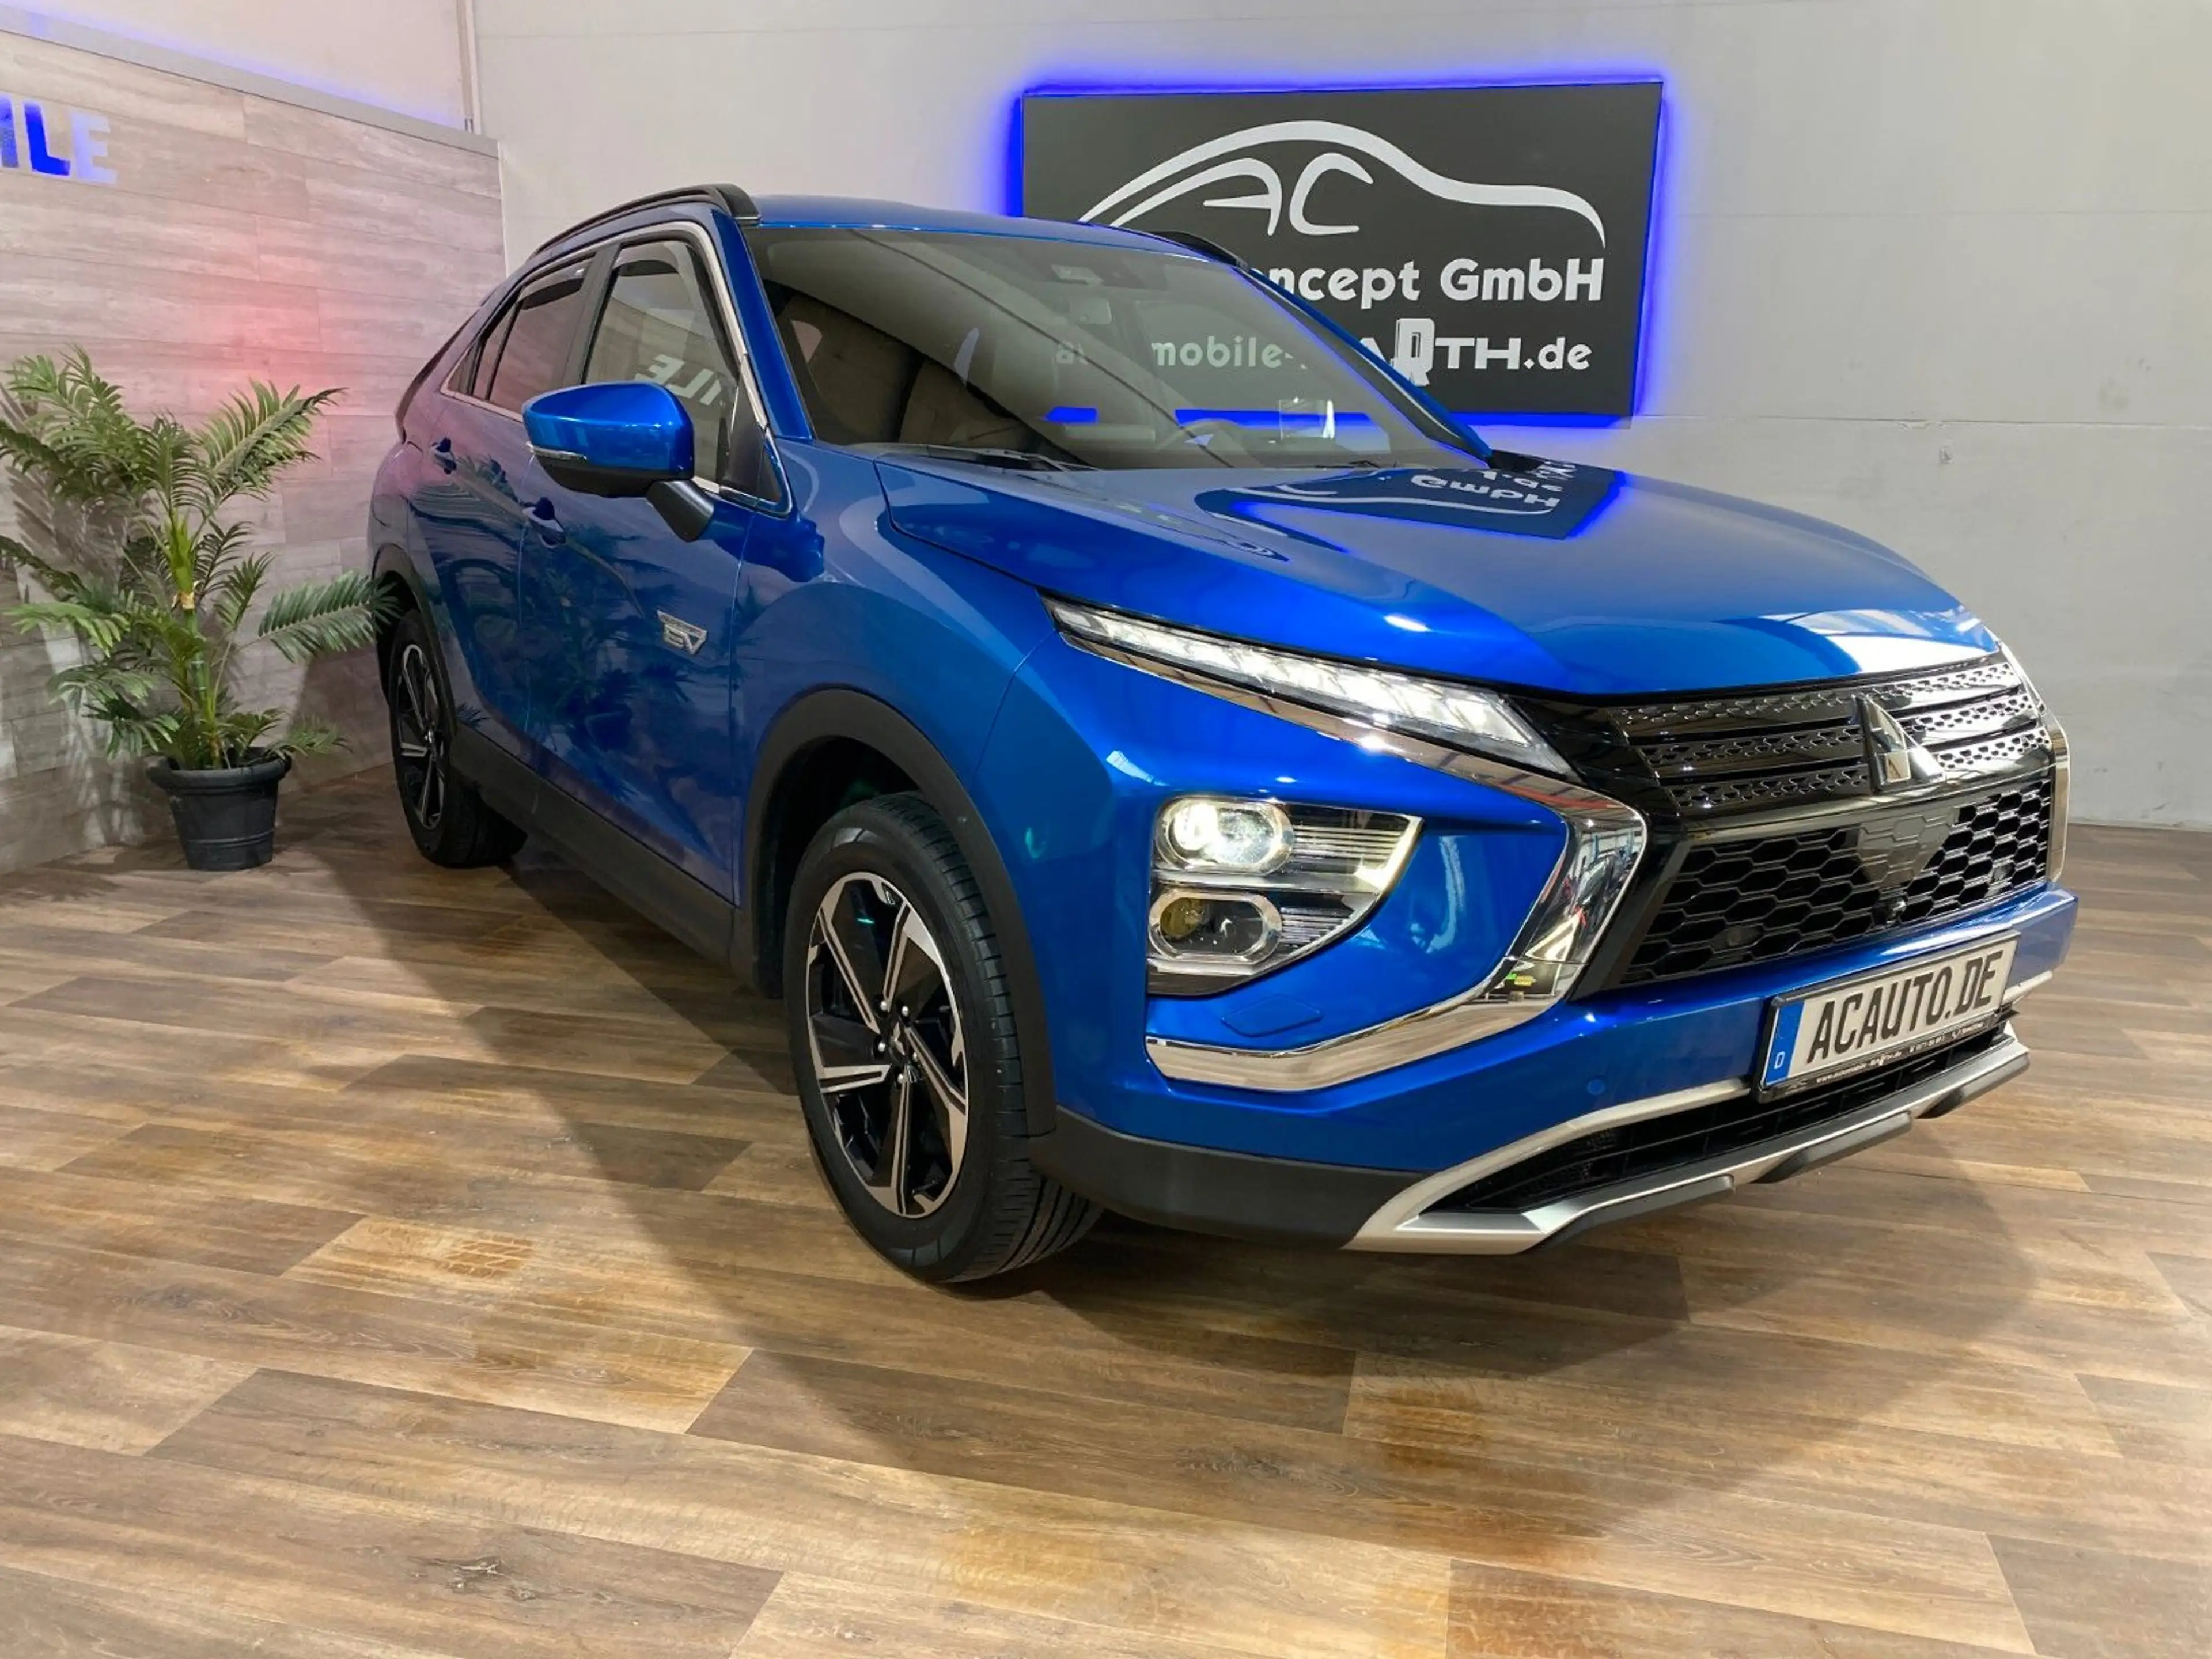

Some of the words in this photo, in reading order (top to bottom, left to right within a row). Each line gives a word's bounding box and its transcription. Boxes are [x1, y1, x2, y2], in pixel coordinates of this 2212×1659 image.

[1109, 152, 1374, 236] AC
[1251, 260, 1421, 310] ncept
[1440, 257, 1604, 301] GmbH
[1806, 950, 2003, 1065] ACAUTO.DE
[1774, 1051, 1785, 1070] D
